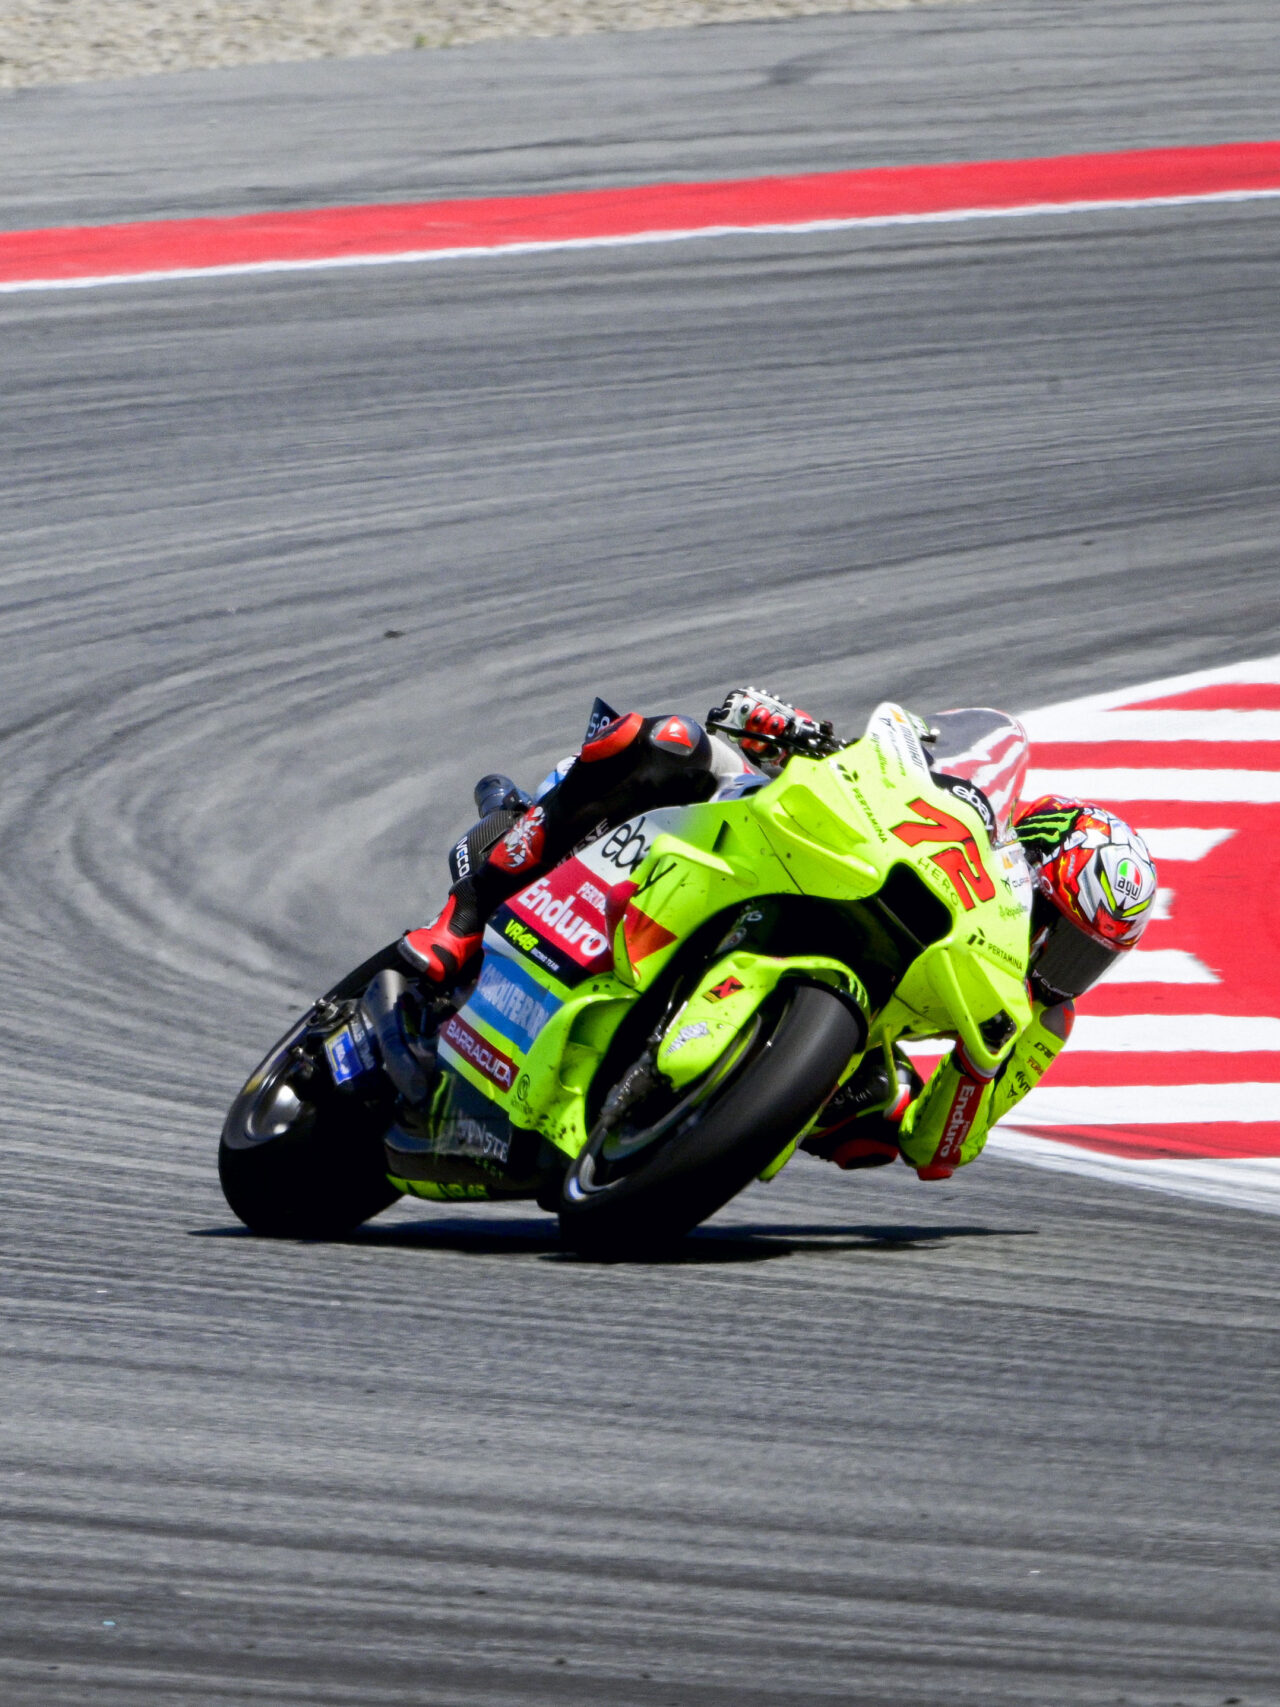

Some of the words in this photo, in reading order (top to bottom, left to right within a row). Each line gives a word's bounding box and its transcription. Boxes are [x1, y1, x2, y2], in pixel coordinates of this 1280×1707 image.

[852, 787, 888, 844] PERTAMINA
[951, 785, 995, 831] ebay
[455, 836, 471, 878] IVECO
[888, 796, 996, 912] 72
[917, 855, 960, 906] HERO
[517, 877, 609, 957] Enduro
[987, 942, 1023, 971] PERTAMINA
[446, 1020, 512, 1088] BARRACUDA
[939, 1084, 976, 1158] Enduro
